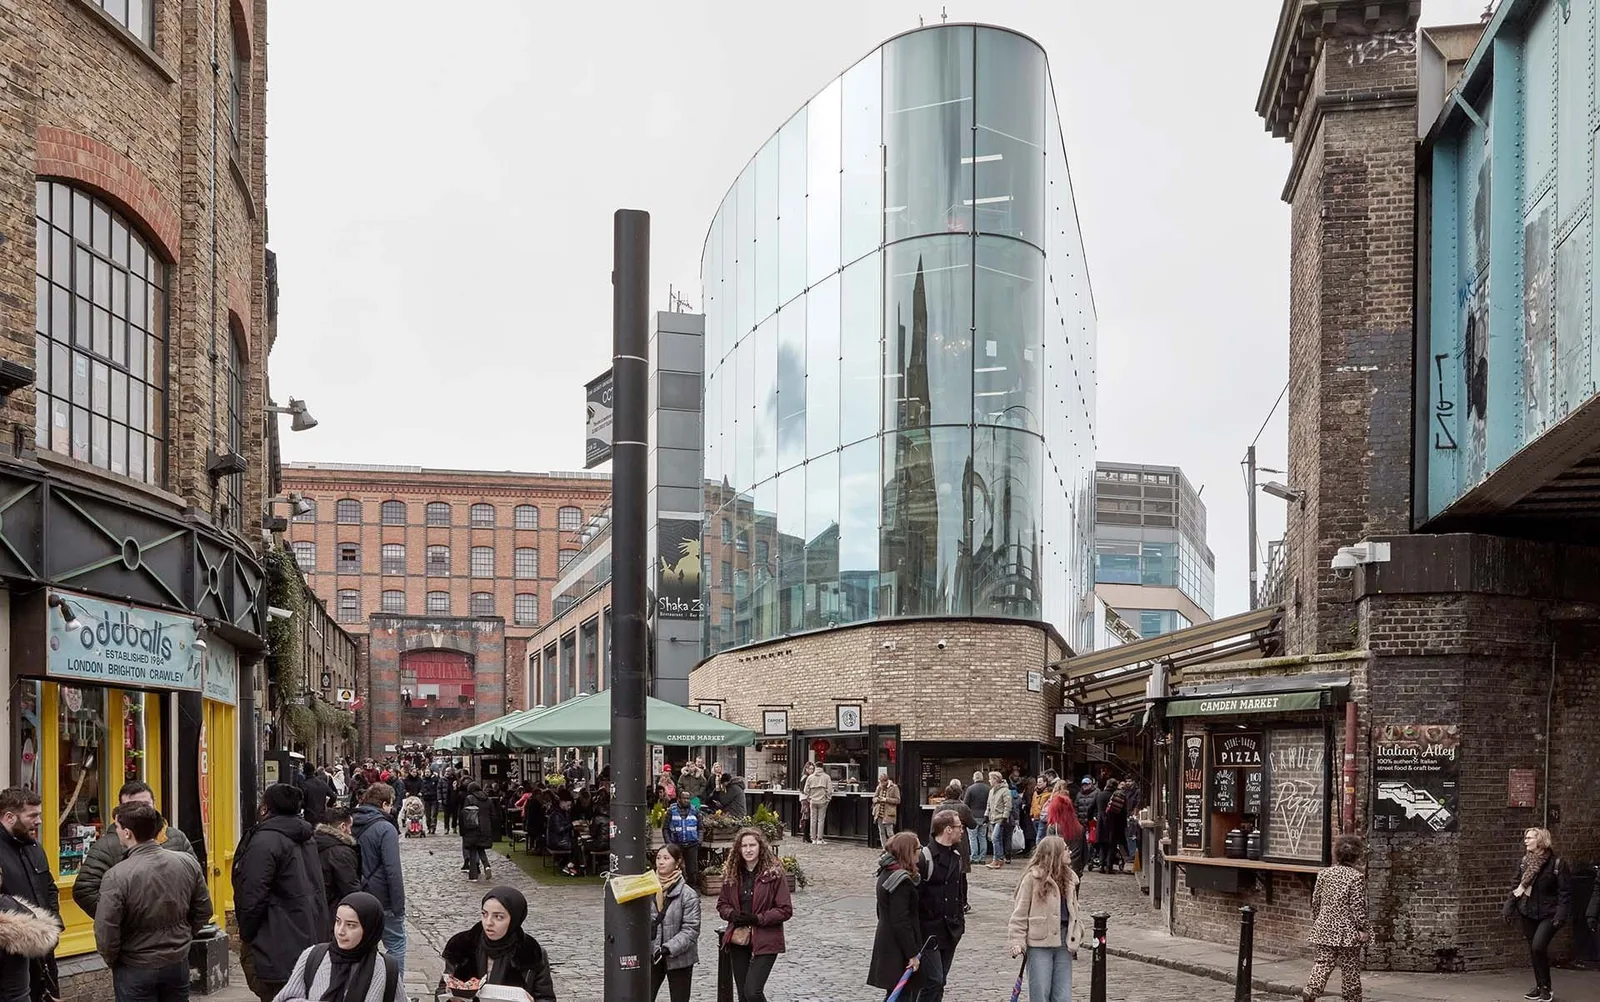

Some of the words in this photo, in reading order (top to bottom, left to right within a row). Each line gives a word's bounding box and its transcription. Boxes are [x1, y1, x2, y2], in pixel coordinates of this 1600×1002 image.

[659, 596, 689, 612] Shaka
[80, 610, 172, 661] oddballs
[105, 649, 149, 664] ESTABLISHED
[150, 656, 165, 666] 1984
[67, 658, 103, 674] LONDON
[108, 663, 146, 678] BRIGHTON
[149, 668, 184, 682] CRAWLEY
[1200, 700, 1237, 712] CAMDEN
[1240, 697, 1279, 710] MARKET
[1221, 751, 1261, 763] PIZZA
[1269, 746, 1324, 773] CAMDEN
[1377, 743, 1418, 756] Italian
[1421, 743, 1455, 760] Alley
